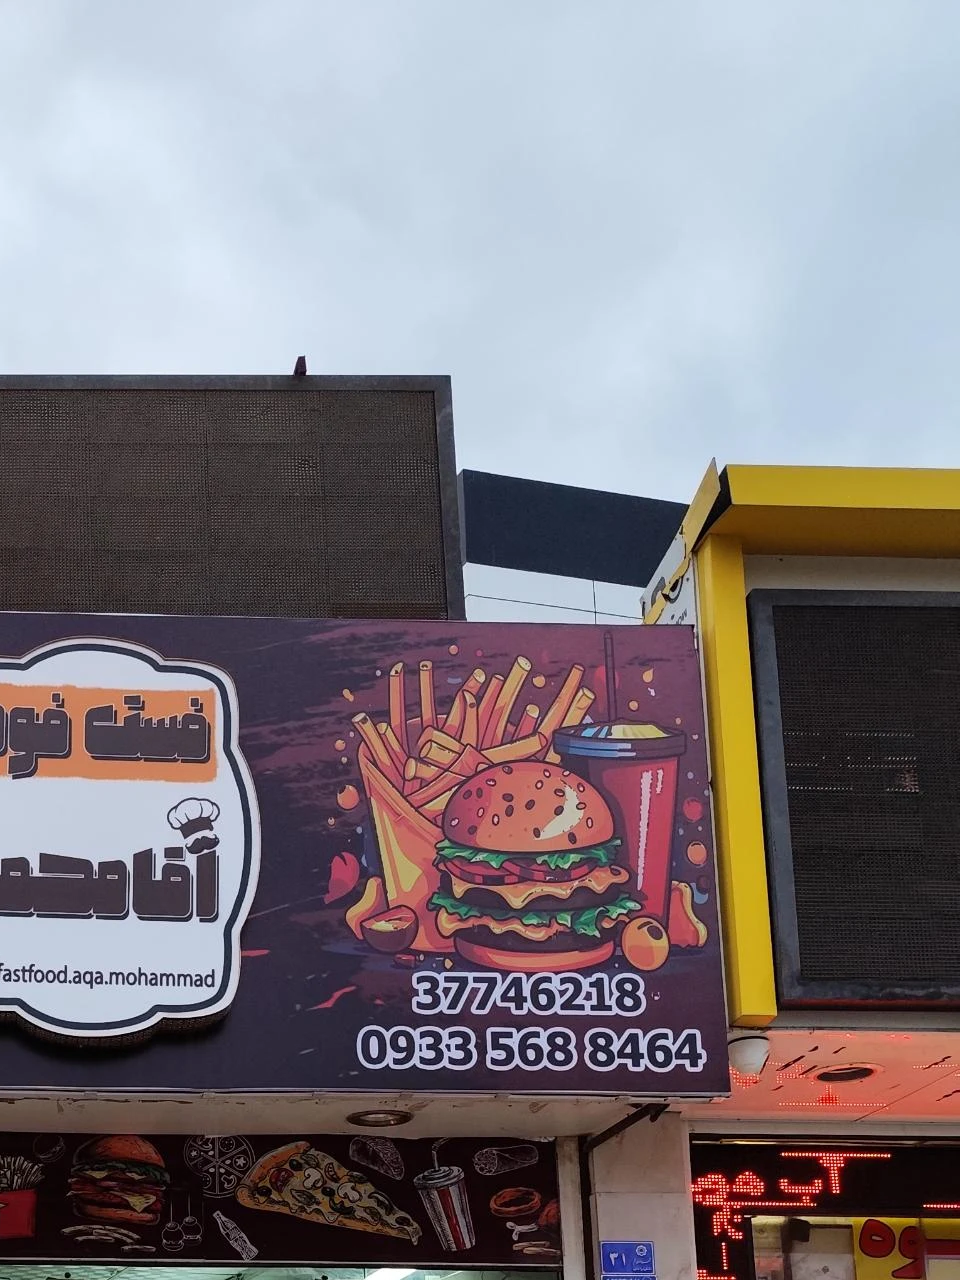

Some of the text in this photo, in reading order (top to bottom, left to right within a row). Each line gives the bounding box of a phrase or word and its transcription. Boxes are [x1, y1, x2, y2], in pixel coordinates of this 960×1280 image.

[84, 694, 212, 764] فست
[411, 971, 647, 1016] 37746218
[356, 1024, 708, 1073] 0933 568 8464
[609, 1251, 626, 1267] ۳۱
